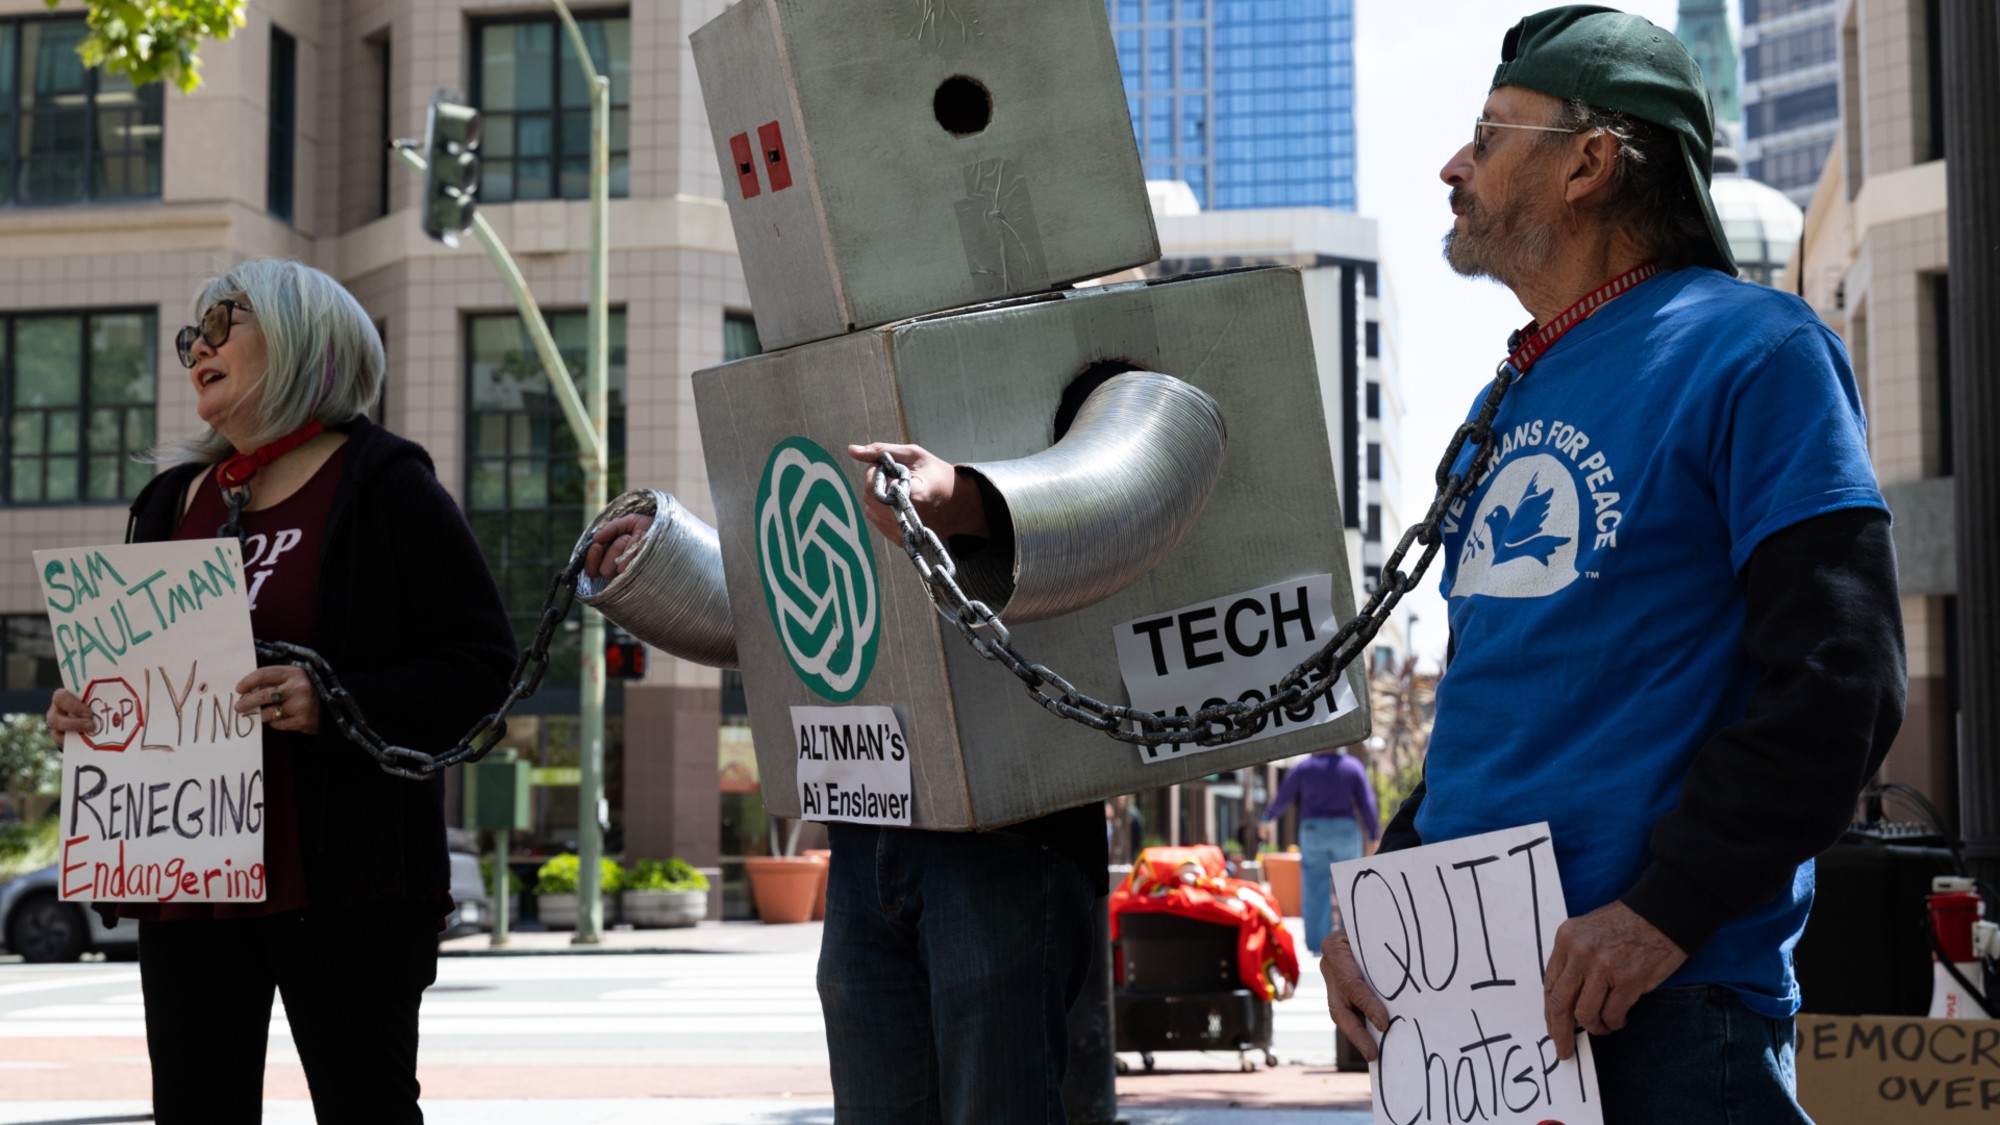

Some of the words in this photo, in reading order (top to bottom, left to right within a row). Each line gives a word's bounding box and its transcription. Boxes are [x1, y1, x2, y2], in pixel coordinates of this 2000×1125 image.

[1444, 419, 1544, 534] VERANS
[1545, 420, 1590, 462] FOR
[1578, 450, 1623, 551] PEACE
[243, 528, 303, 568] OP
[44, 551, 127, 613] SAM
[1132, 586, 1316, 677] TECH
[800, 724, 905, 761] ALTMAN's
[803, 782, 821, 814] Ai
[825, 782, 909, 819] Enslaver
[63, 836, 265, 901] Endangering
[1351, 836, 1550, 1001] QUIT
[1795, 1022, 2000, 1069] EMOCR
